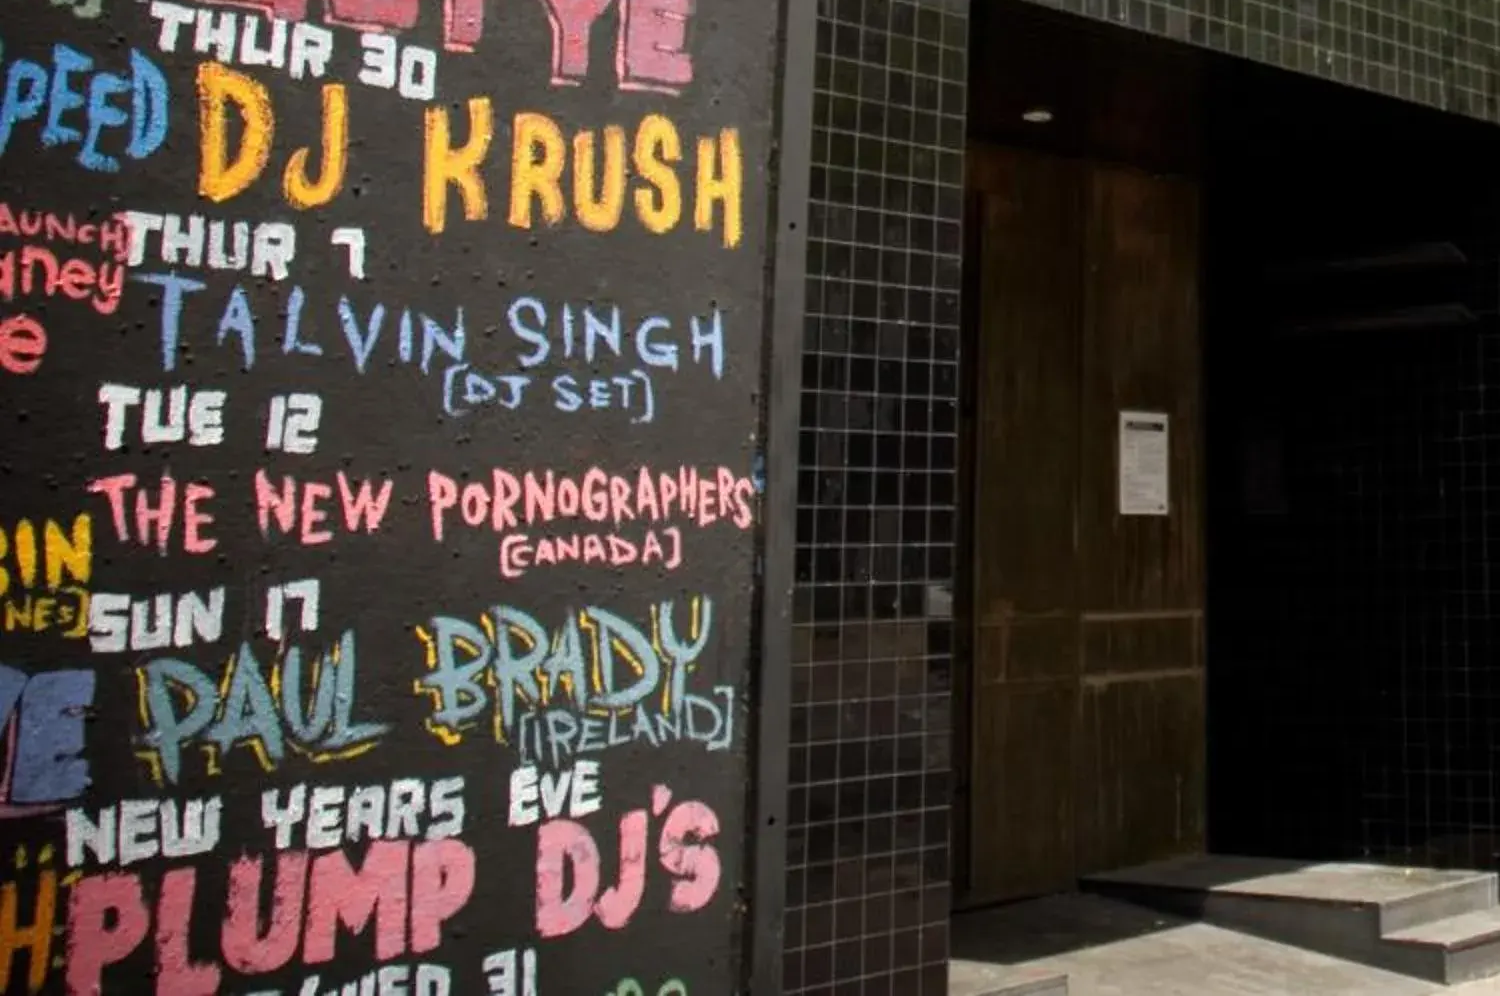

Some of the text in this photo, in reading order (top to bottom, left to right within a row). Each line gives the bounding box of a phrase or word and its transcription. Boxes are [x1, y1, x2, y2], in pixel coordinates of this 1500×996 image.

[151, 0, 437, 101] THUR 30
[196, 60, 744, 249] DJ KRUSH
[124, 210, 366, 281] THUR 7
[131, 270, 724, 380] TALVIN SINGH
[99, 382, 322, 453] TUE 12
[85, 464, 755, 555] THE NEW PORNOGRAPHERS
[88, 578, 320, 653] SUN 17
[134, 594, 711, 784] PAUL BRADY
[65, 760, 602, 867] NEW YEARS EVE
[65, 784, 722, 996] PLUMP DJ'S
